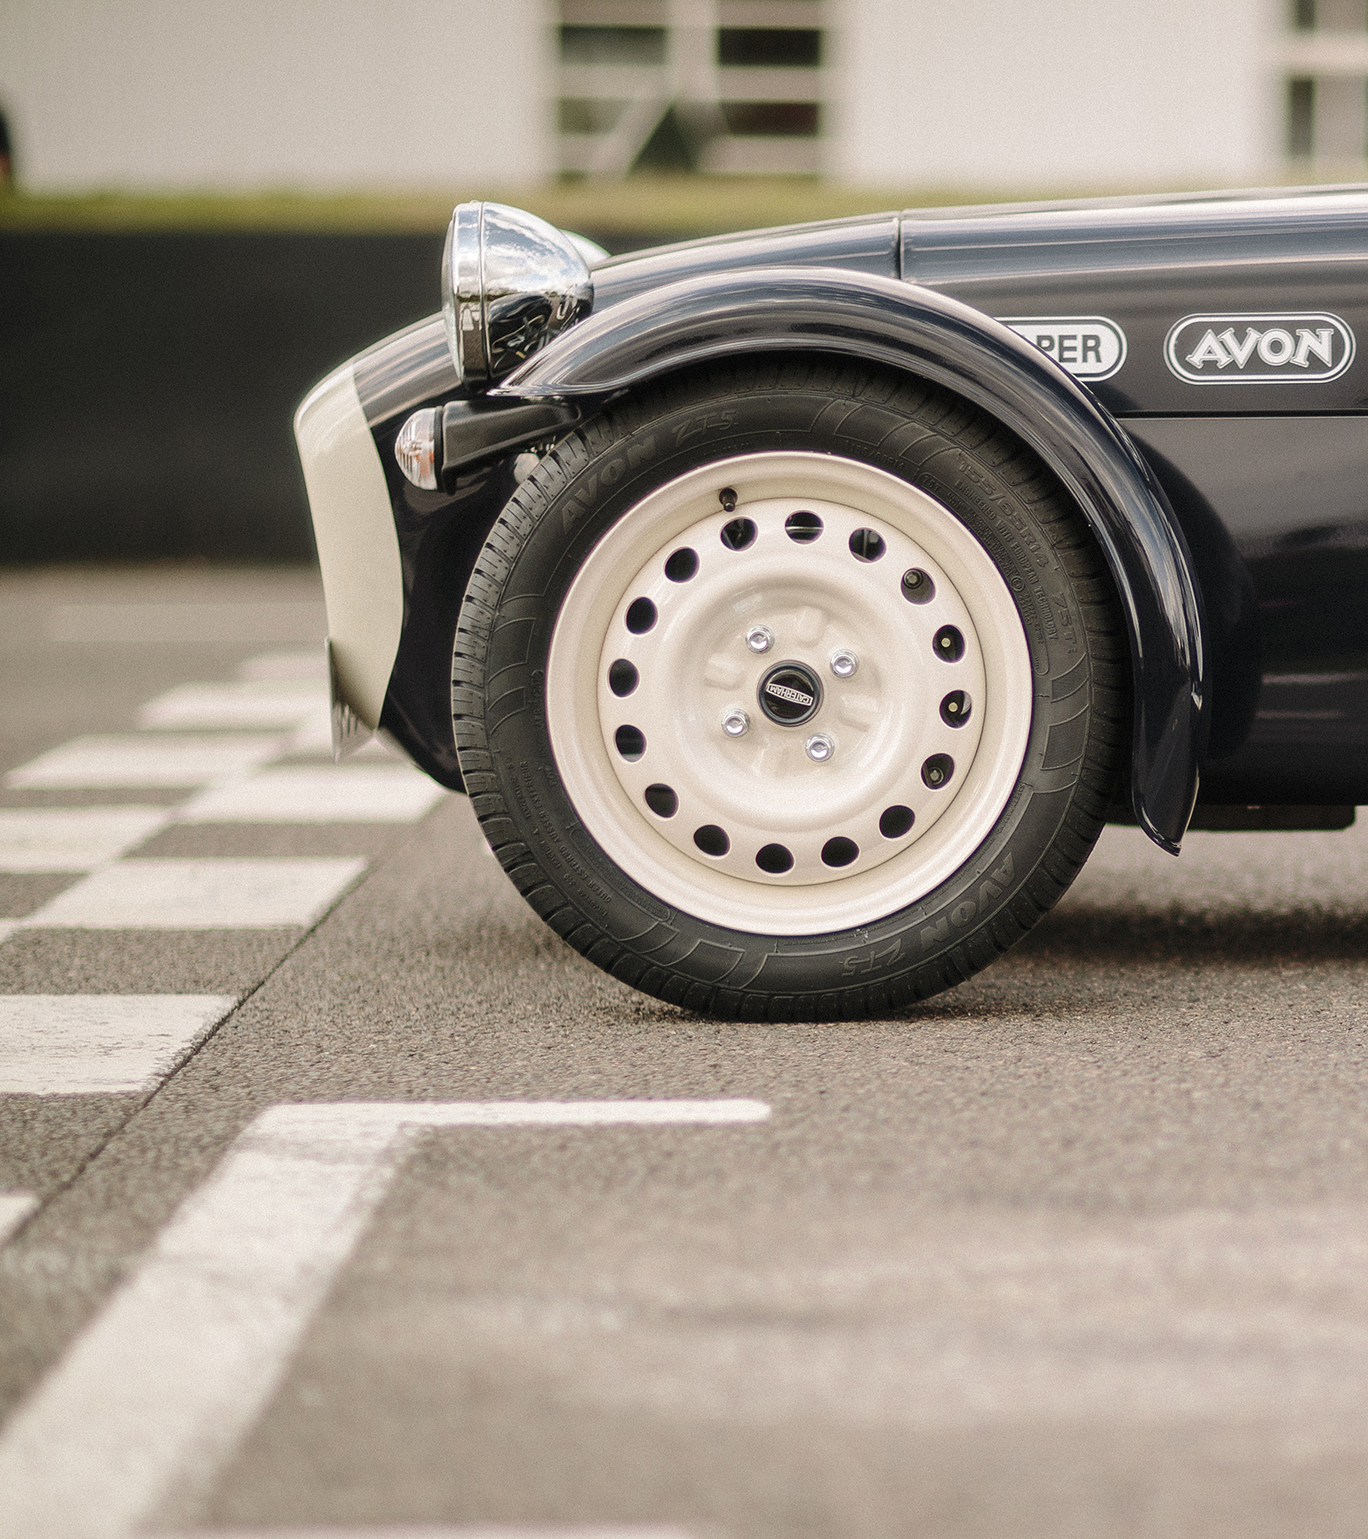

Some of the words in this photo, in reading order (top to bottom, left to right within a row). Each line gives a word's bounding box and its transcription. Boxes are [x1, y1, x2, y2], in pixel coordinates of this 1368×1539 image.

[1036, 334, 1102, 363] PER
[1186, 327, 1334, 369] AVON
[561, 432, 658, 535] AVON
[954, 478, 998, 521] ENGINEERED
[994, 519, 1014, 542] WITH
[1009, 540, 1039, 584] EUROPEAN
[1033, 585, 1058, 640] TECHNOLOGY
[957, 460, 1050, 568] 155/65R14
[1053, 591, 1076, 645] 75T
[768, 684, 811, 704] CATERHAM
[920, 852, 1016, 951] AVON
